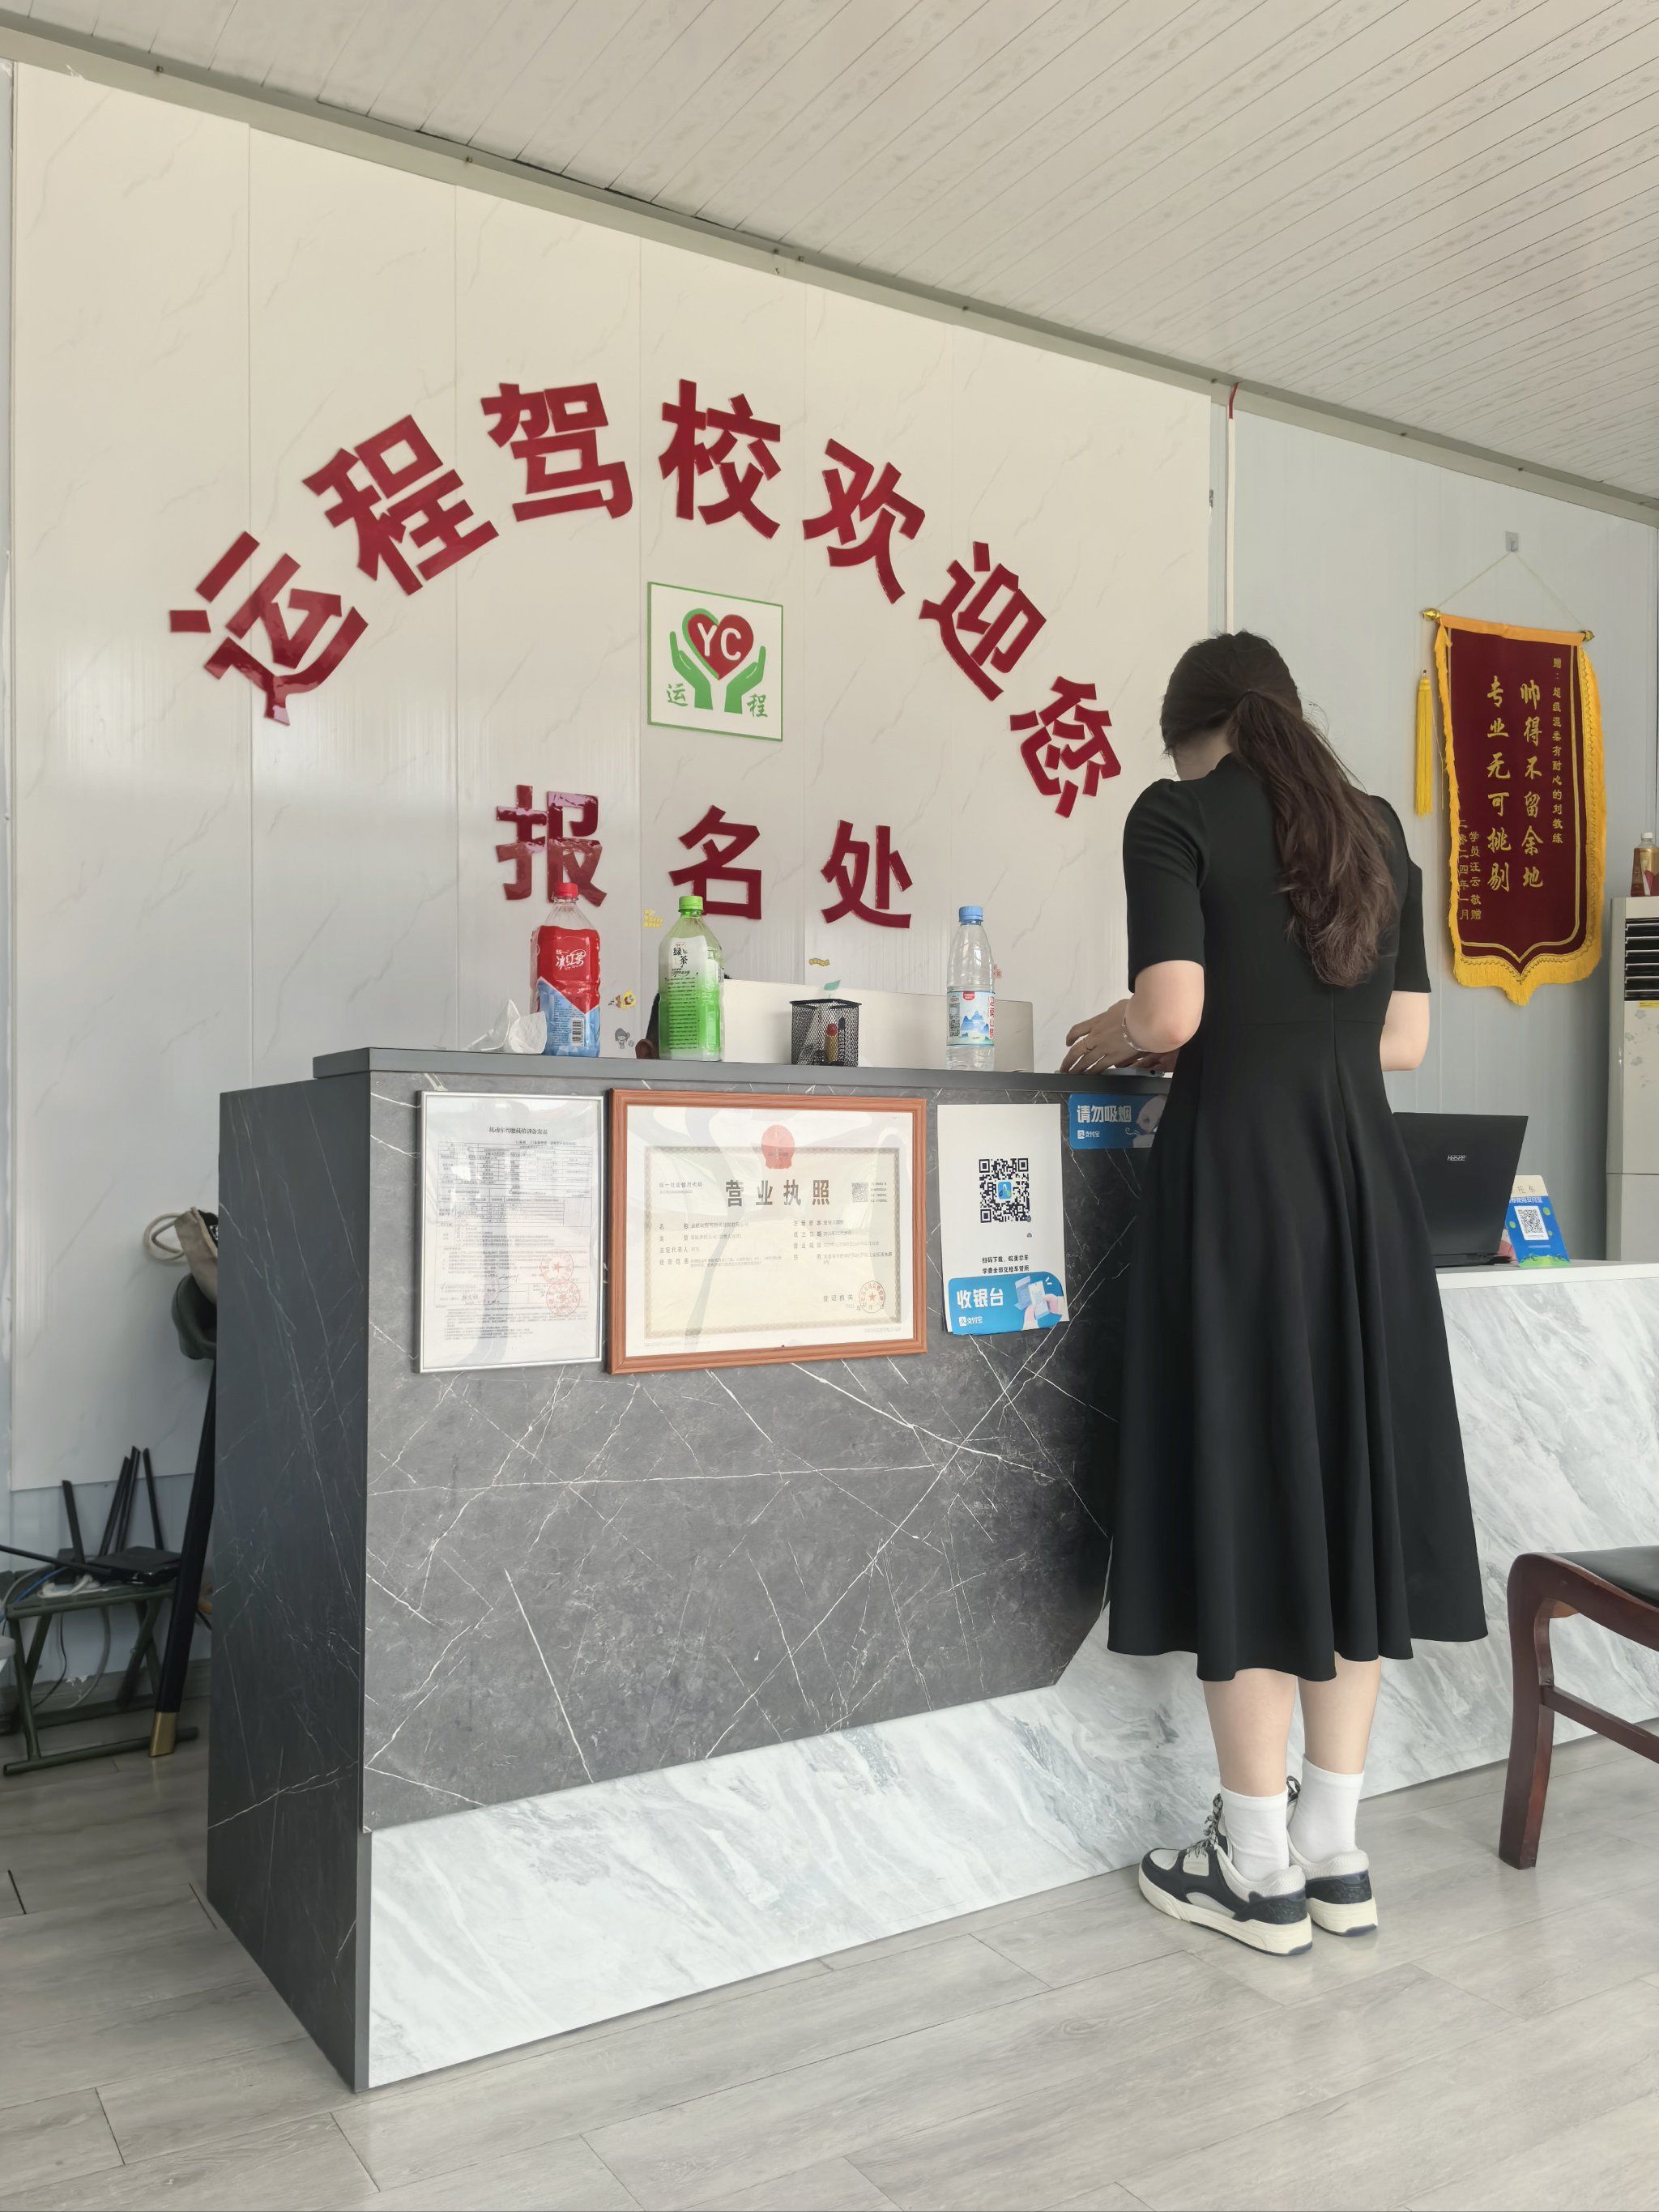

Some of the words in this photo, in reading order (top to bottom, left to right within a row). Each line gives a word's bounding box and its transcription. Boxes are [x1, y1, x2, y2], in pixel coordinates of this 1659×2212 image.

[170, 379, 1121, 819] 运程驾校欢迎您
[697, 623, 742, 661] YC
[1486, 676, 1512, 892] 专业无可挑剔
[1520, 679, 1544, 888] 帅得不留余地
[497, 785, 913, 929] 报名处
[1077, 1105, 1132, 1123] 请勿吸烟
[725, 1178, 830, 1208] 营业执照
[957, 1288, 1004, 1309] 收银台
